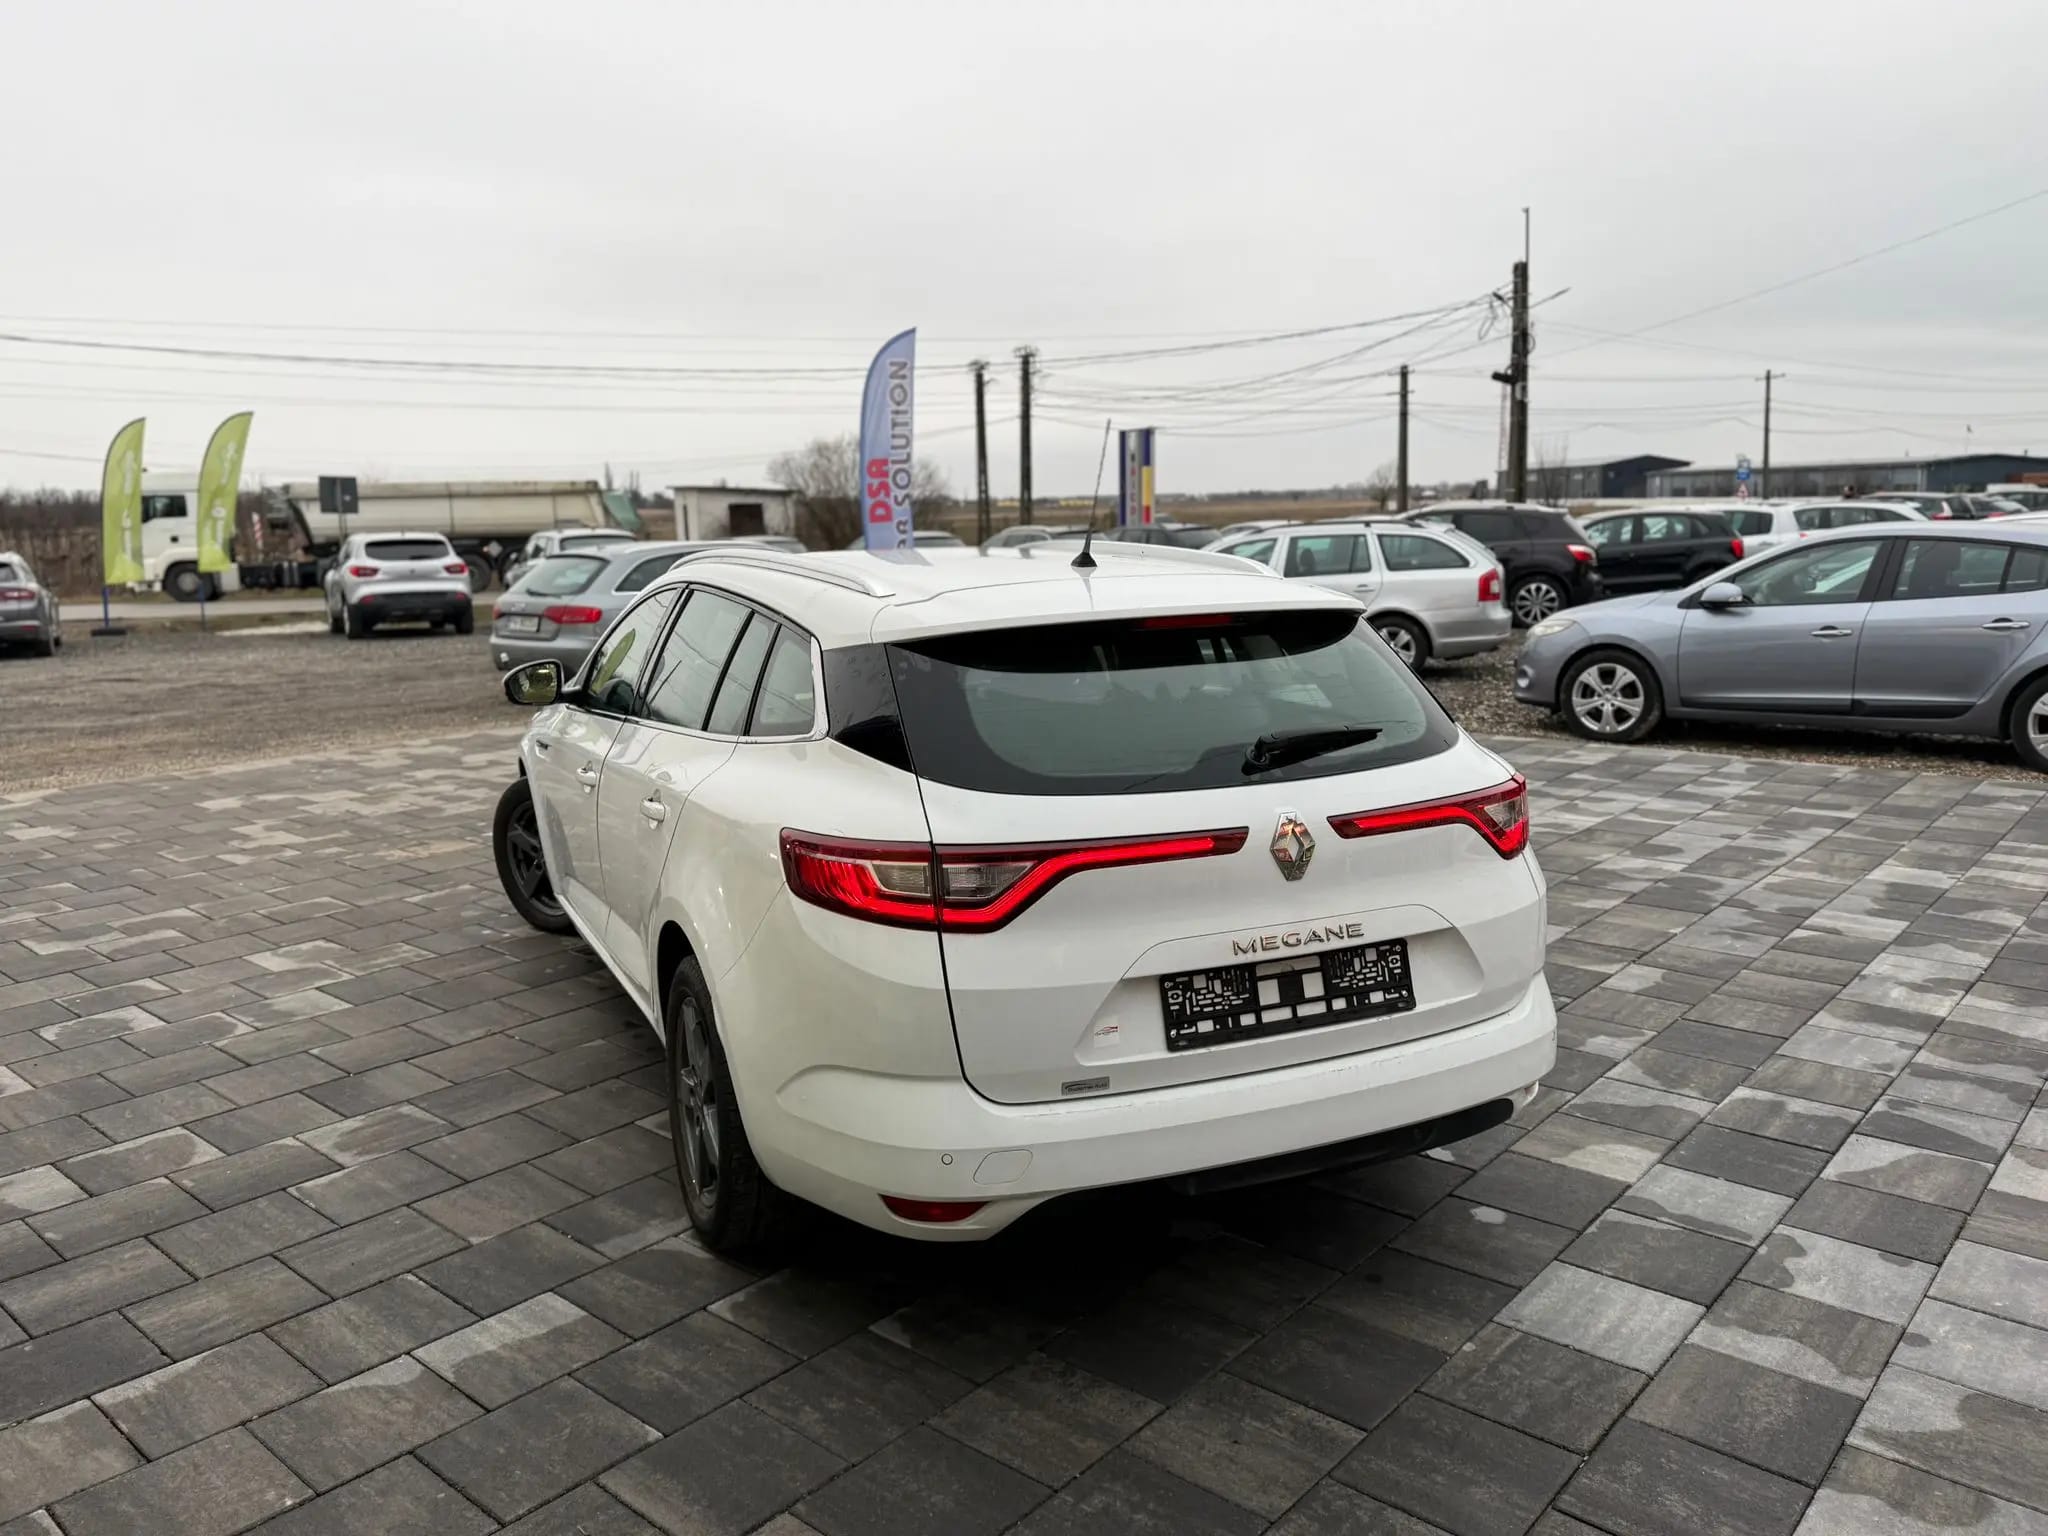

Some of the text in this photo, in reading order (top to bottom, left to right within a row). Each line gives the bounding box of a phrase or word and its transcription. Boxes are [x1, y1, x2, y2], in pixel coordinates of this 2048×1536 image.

[888, 361, 911, 507] SOLUTION
[866, 458, 893, 524] DSA
[1232, 922, 1365, 956] MEGANE
